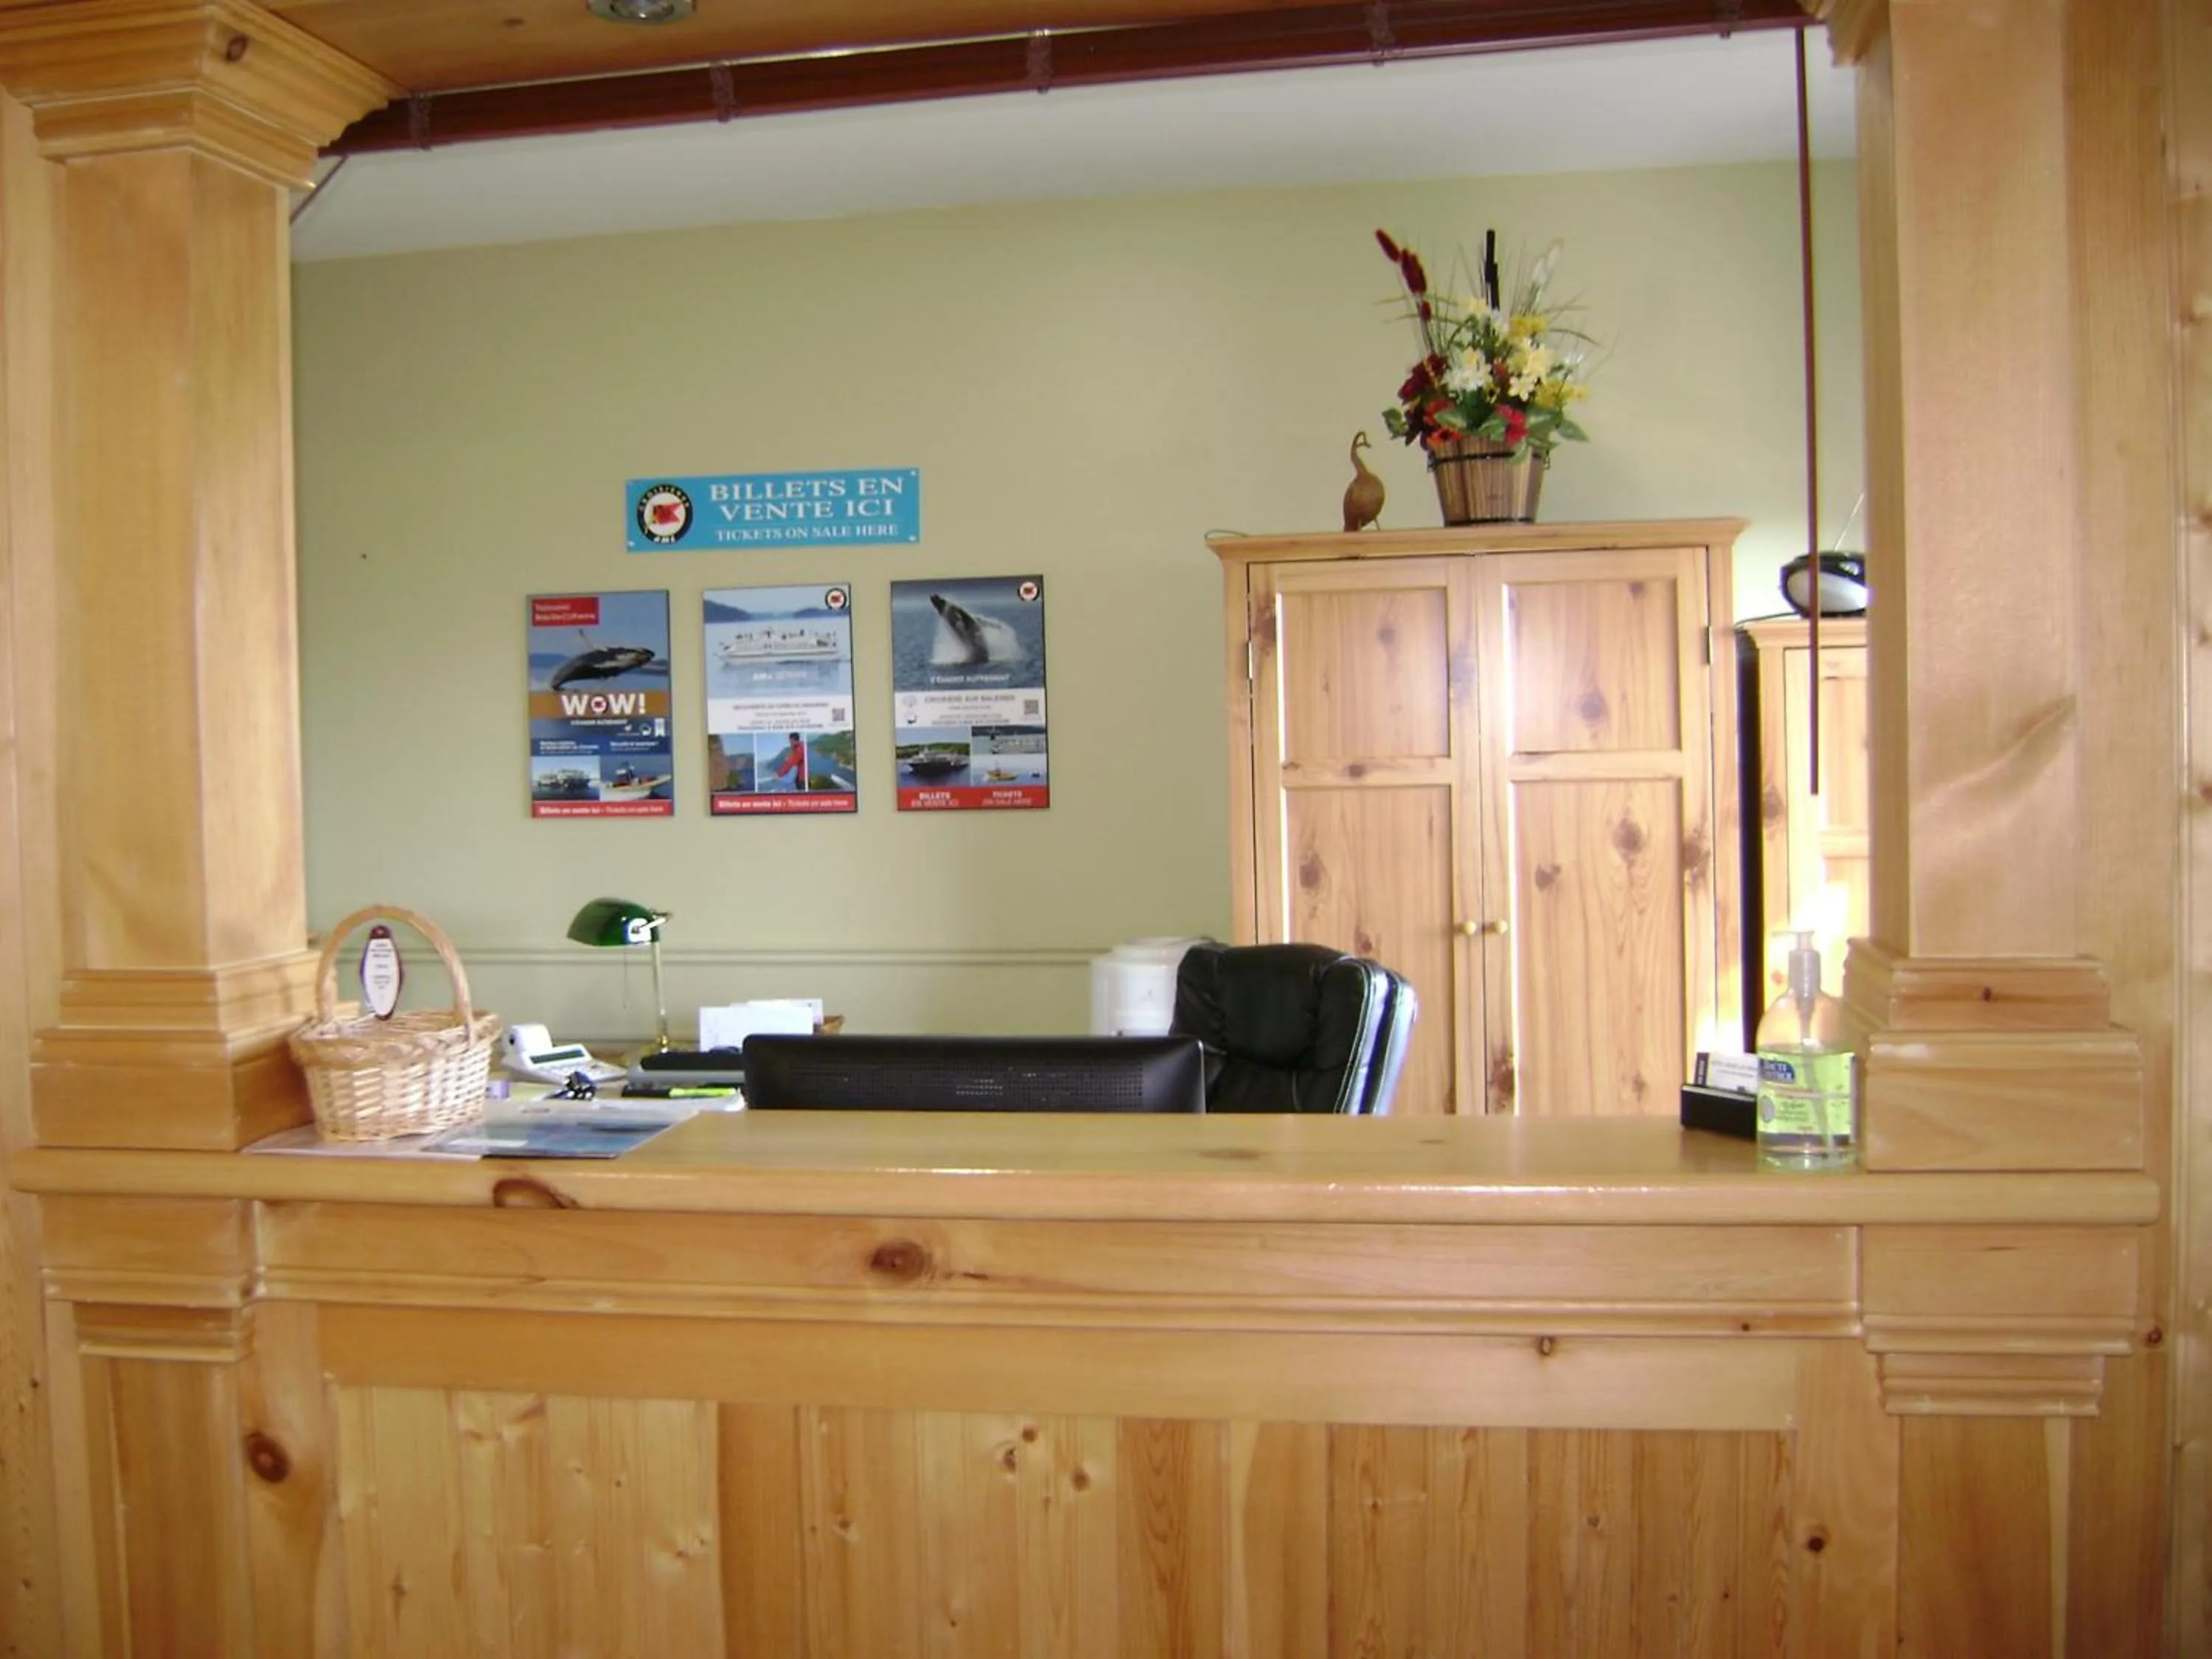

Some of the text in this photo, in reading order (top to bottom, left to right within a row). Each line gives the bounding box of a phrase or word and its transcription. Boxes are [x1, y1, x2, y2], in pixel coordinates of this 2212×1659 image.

[710, 476, 903, 501] BILLETS EN
[719, 498, 893, 521] VENTE ICI
[716, 523, 899, 542] TICKETS ON SALE HERE
[561, 692, 647, 716] WOW!
